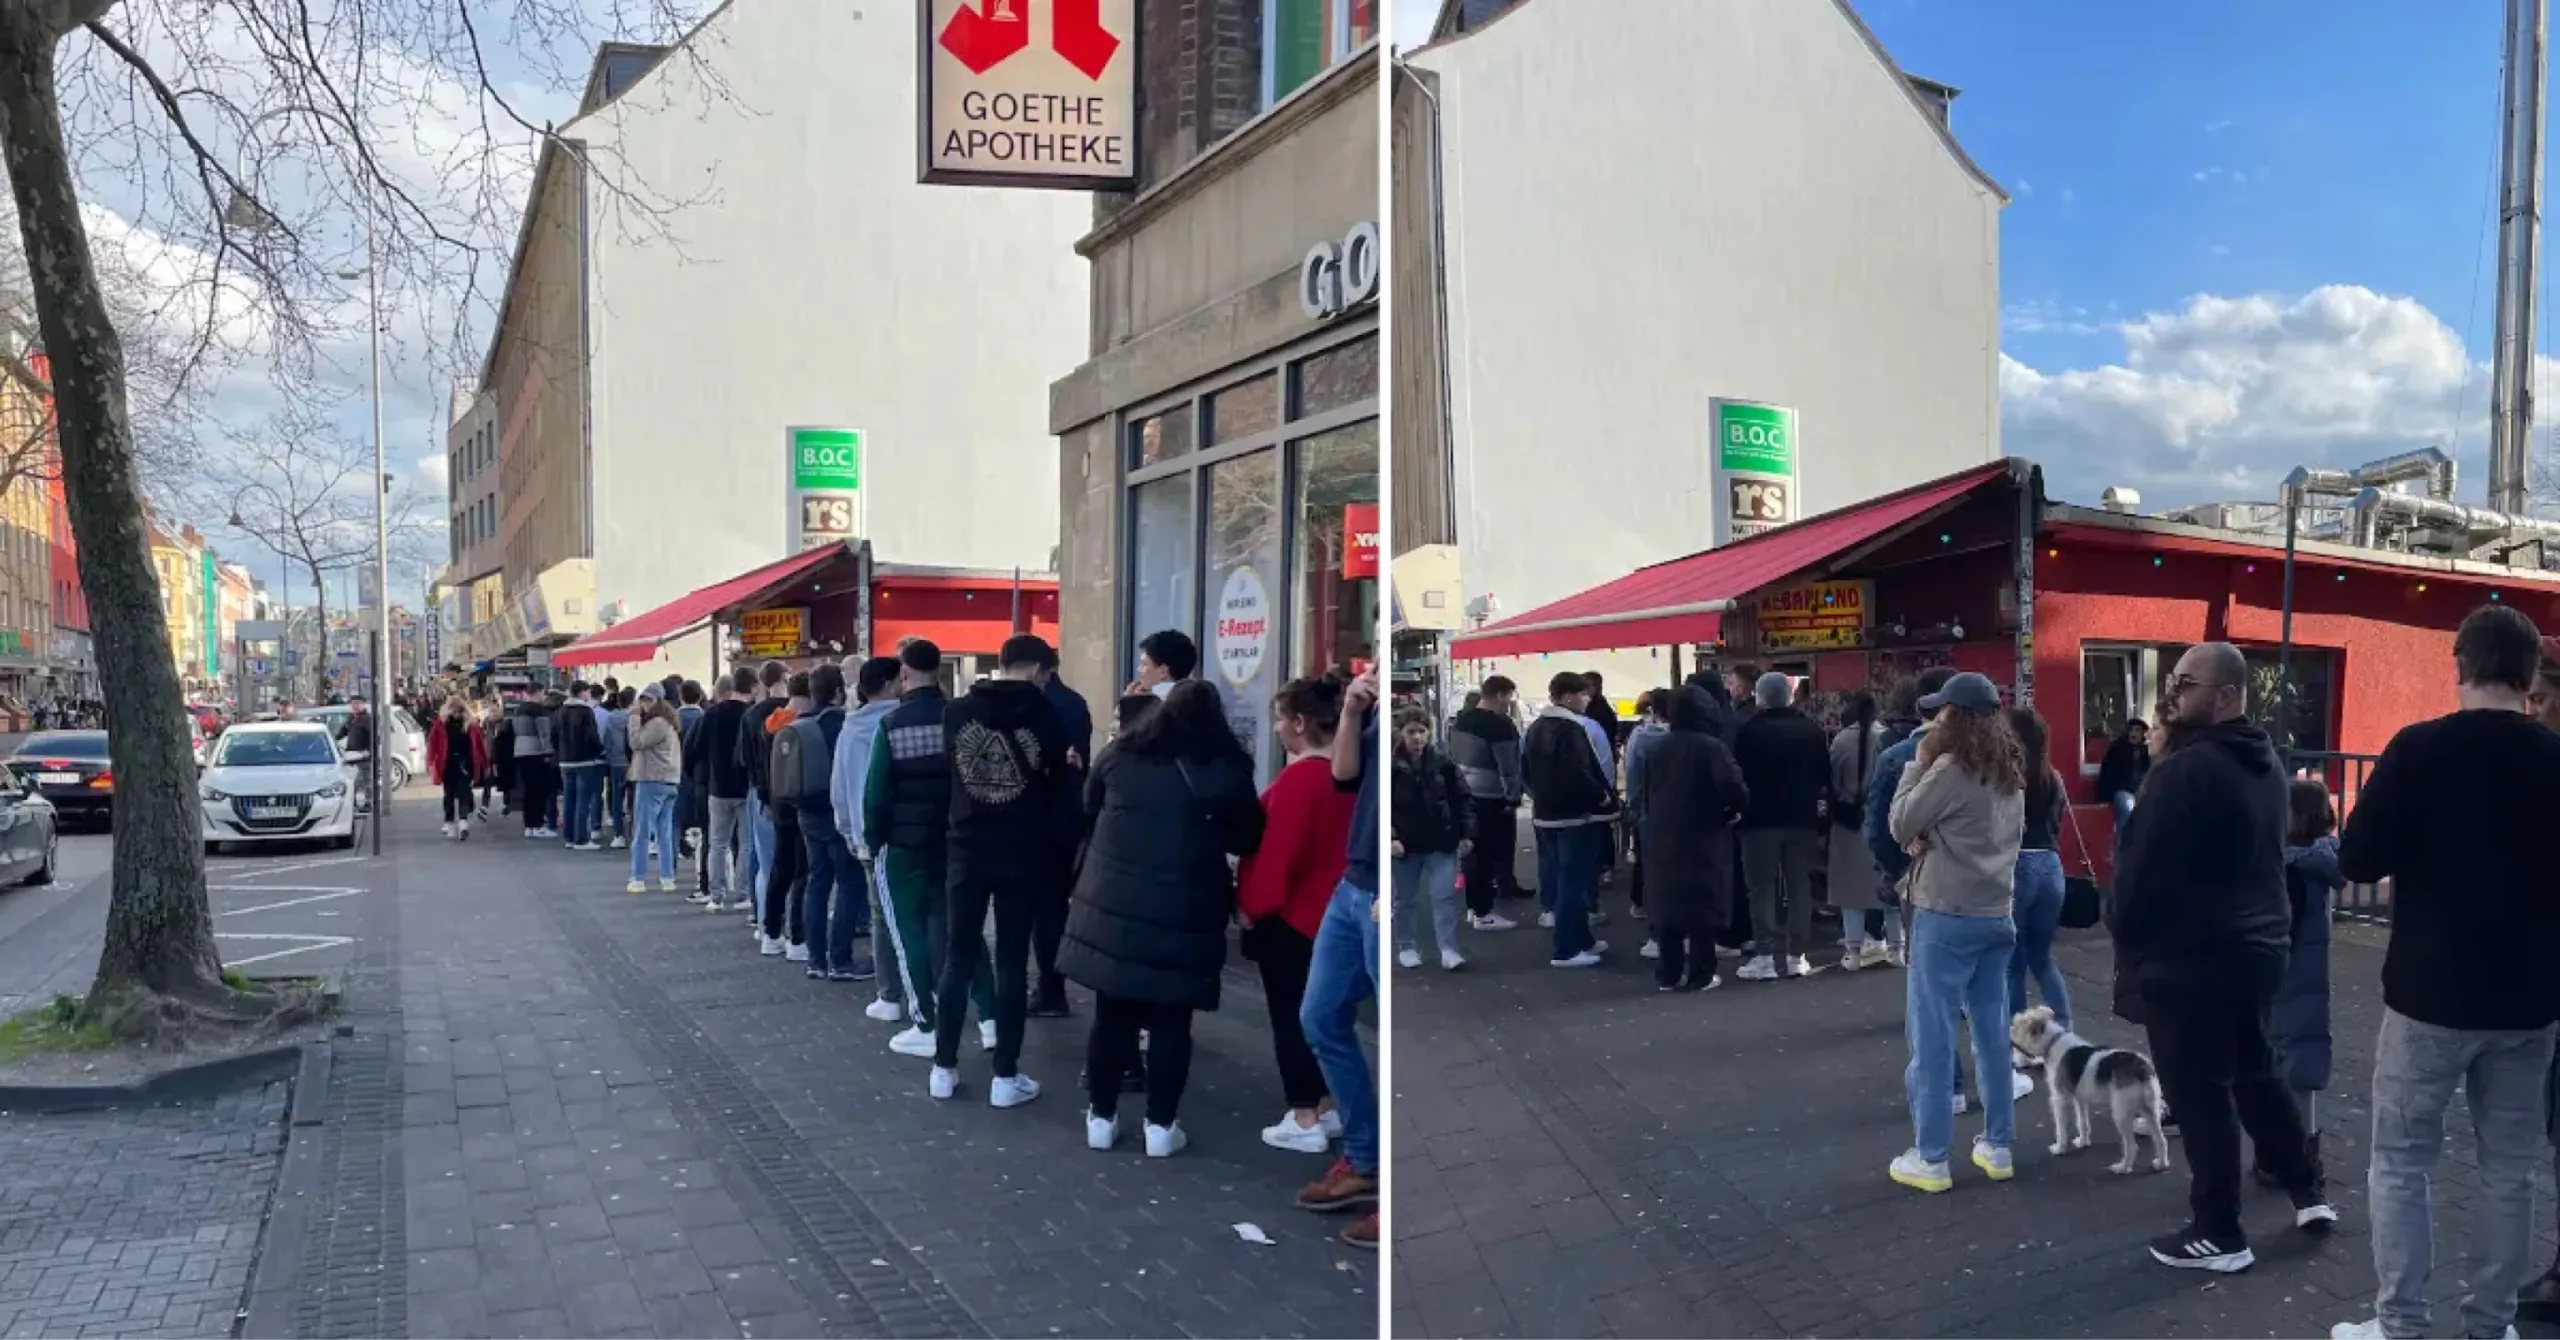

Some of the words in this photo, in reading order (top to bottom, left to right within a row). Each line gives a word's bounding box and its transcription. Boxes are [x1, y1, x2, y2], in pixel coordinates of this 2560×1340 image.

[962, 90, 1104, 126] GOETHE
[942, 129, 1123, 165] APOTHEKE
[806, 501, 850, 530] rs
[1734, 483, 1783, 519] rs
[1218, 617, 1265, 641] E-Rezept
